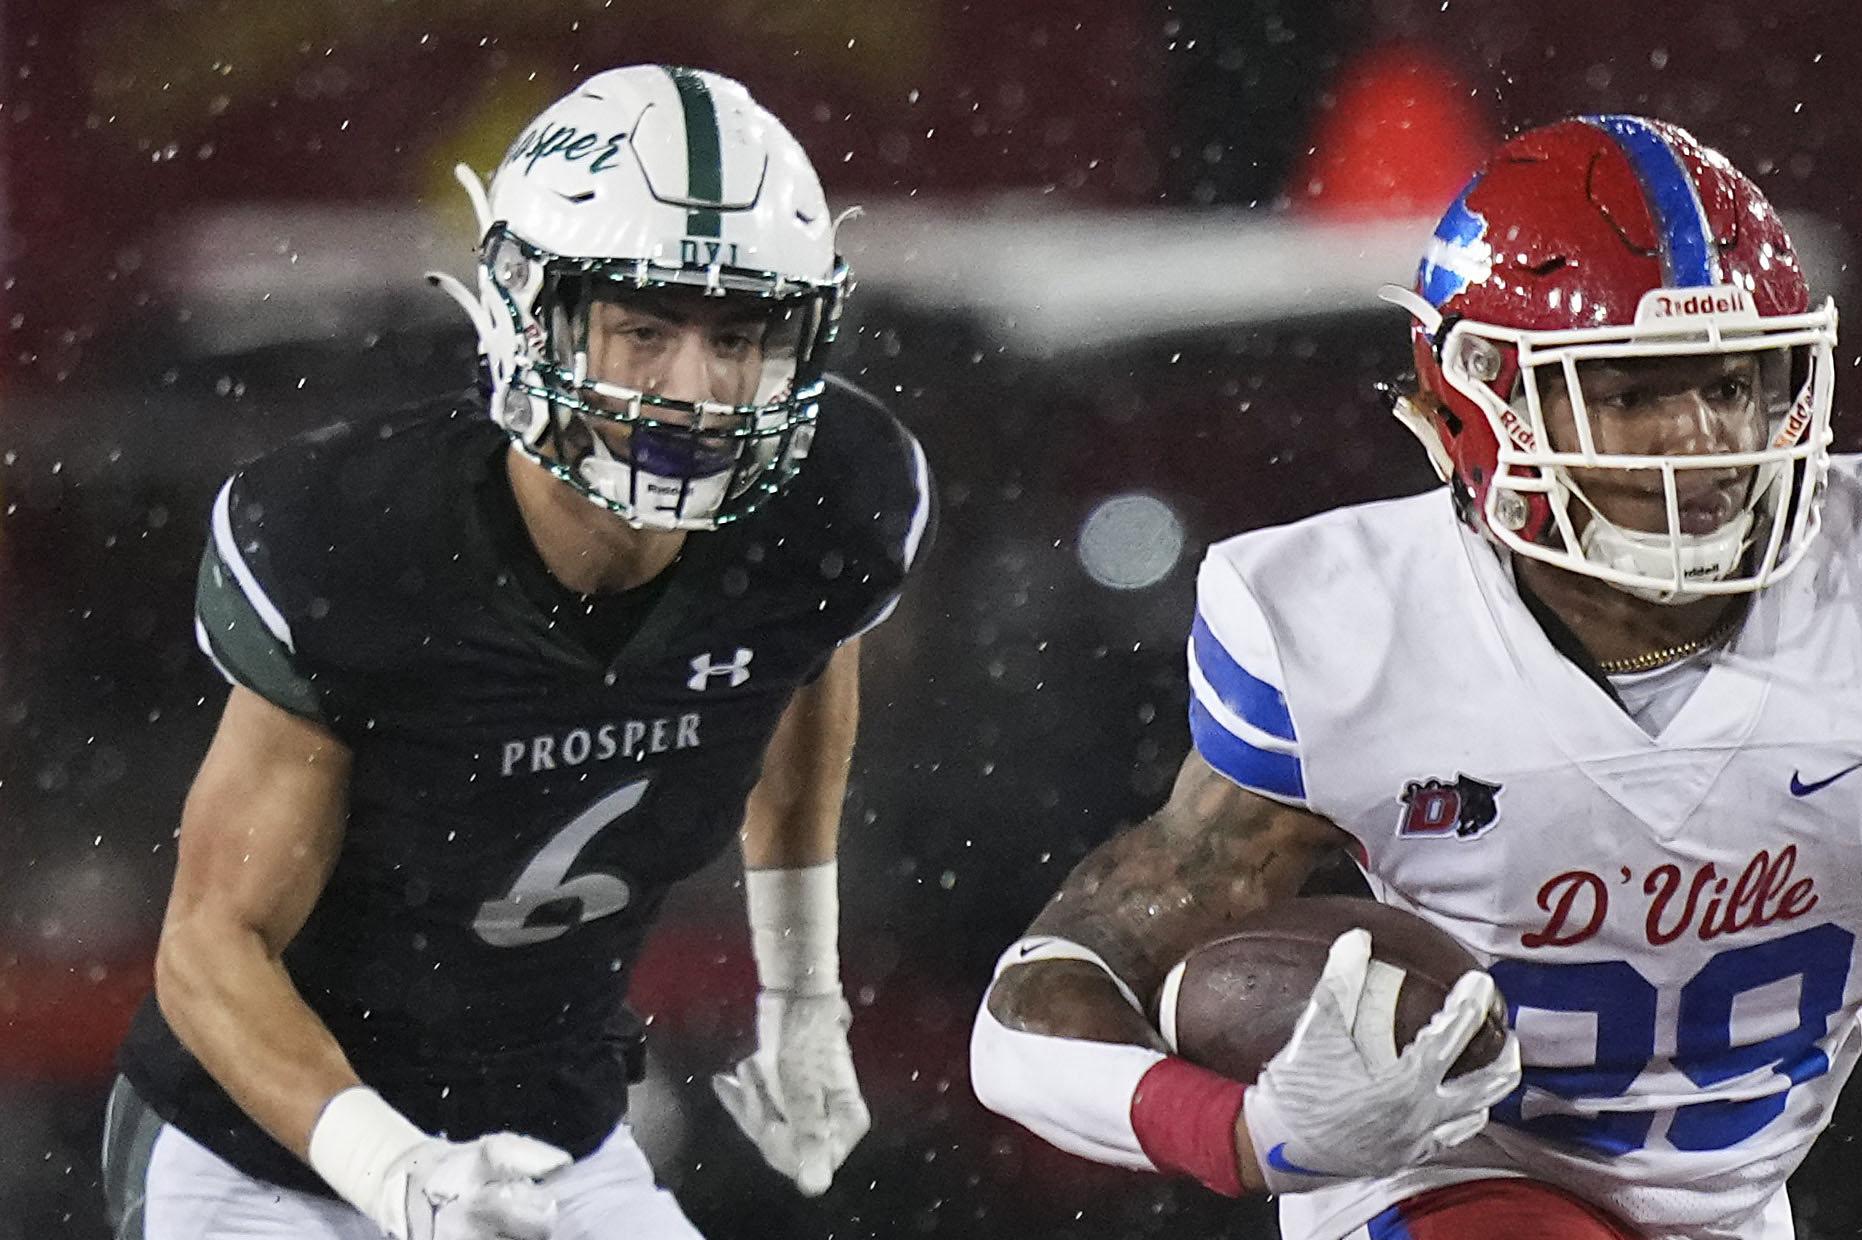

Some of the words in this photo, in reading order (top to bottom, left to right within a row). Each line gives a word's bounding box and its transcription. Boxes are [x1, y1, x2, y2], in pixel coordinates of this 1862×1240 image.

[500, 713, 701, 776] PROSPER
[472, 778, 650, 948] 6
[1520, 844, 1819, 949] D'Ville
